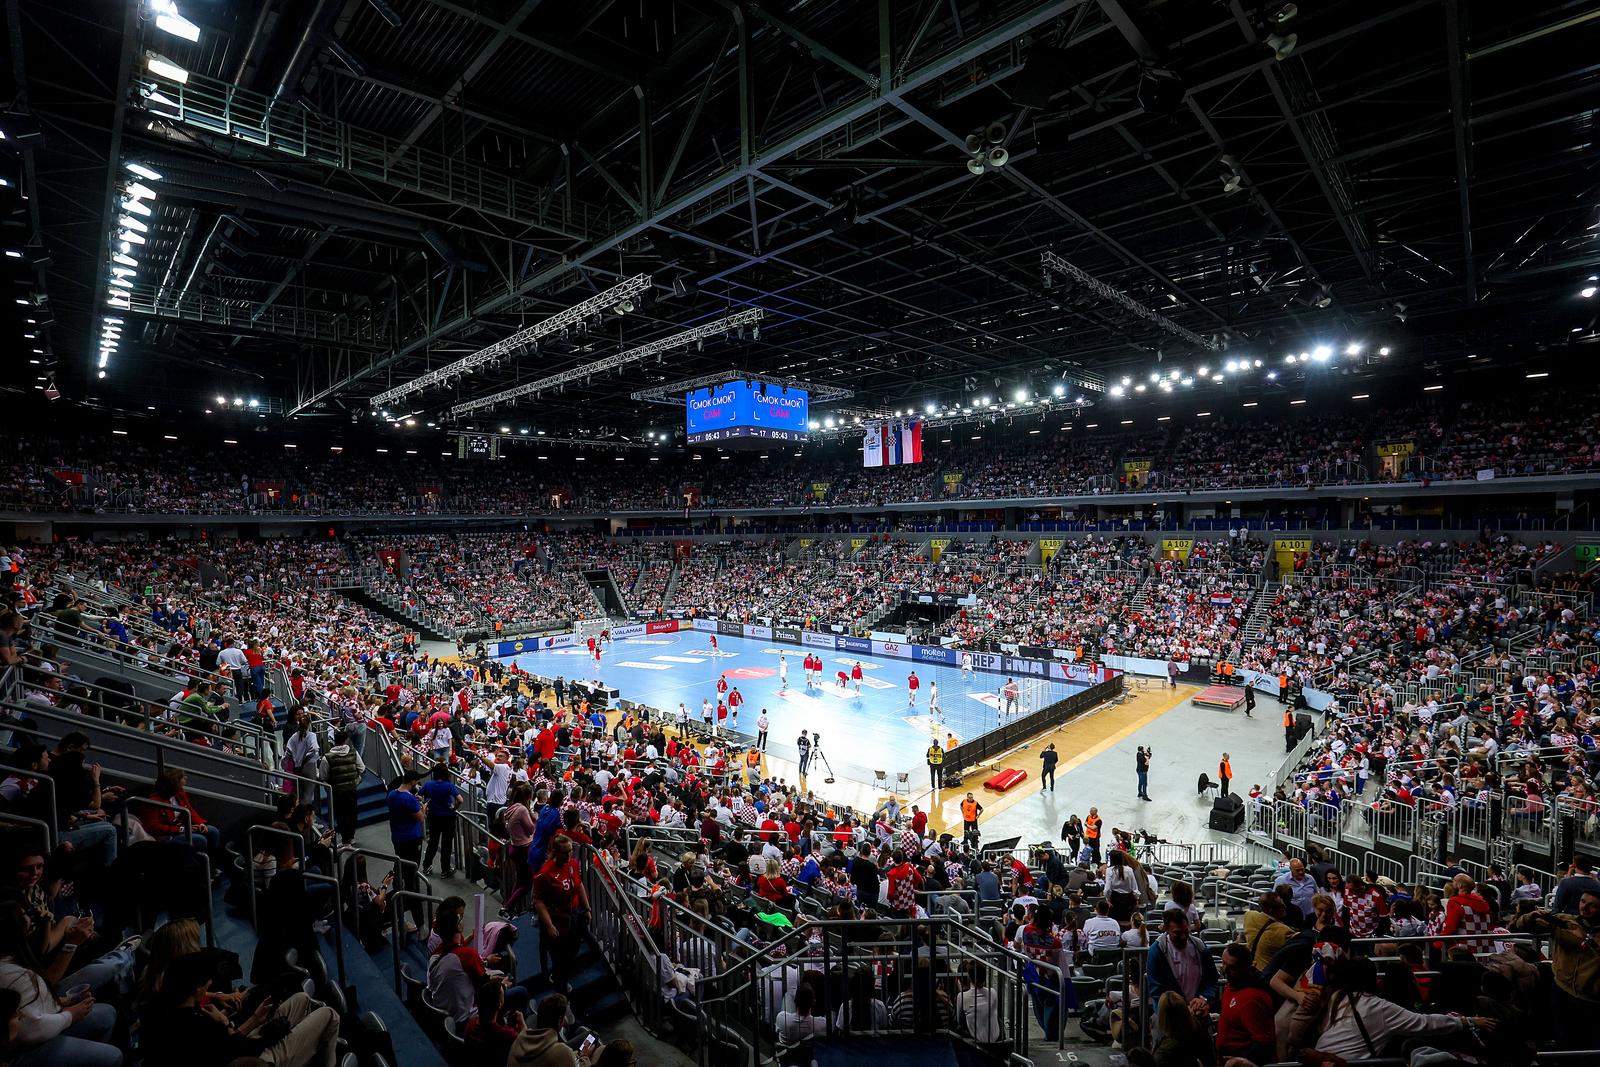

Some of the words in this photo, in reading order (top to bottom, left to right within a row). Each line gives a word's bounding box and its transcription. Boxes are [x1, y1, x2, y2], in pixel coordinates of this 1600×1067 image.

[693, 399, 711, 409] CMOK
[712, 394, 732, 406] CMOK
[757, 394, 779, 405] CMOK
[780, 398, 800, 408] CMOK
[703, 408, 721, 420] CAM
[769, 406, 790, 418] CAM
[705, 431, 720, 441] 05:43
[725, 430, 730, 438] 9
[771, 431, 788, 440] 05:43
[1392, 444, 1408, 453] 301
[1584, 547, 1590, 556] D
[884, 643, 899, 651] GAZ
[921, 648, 946, 657] molten
[973, 654, 995, 667] HEP
[1055, 1051, 1078, 1062] 16
